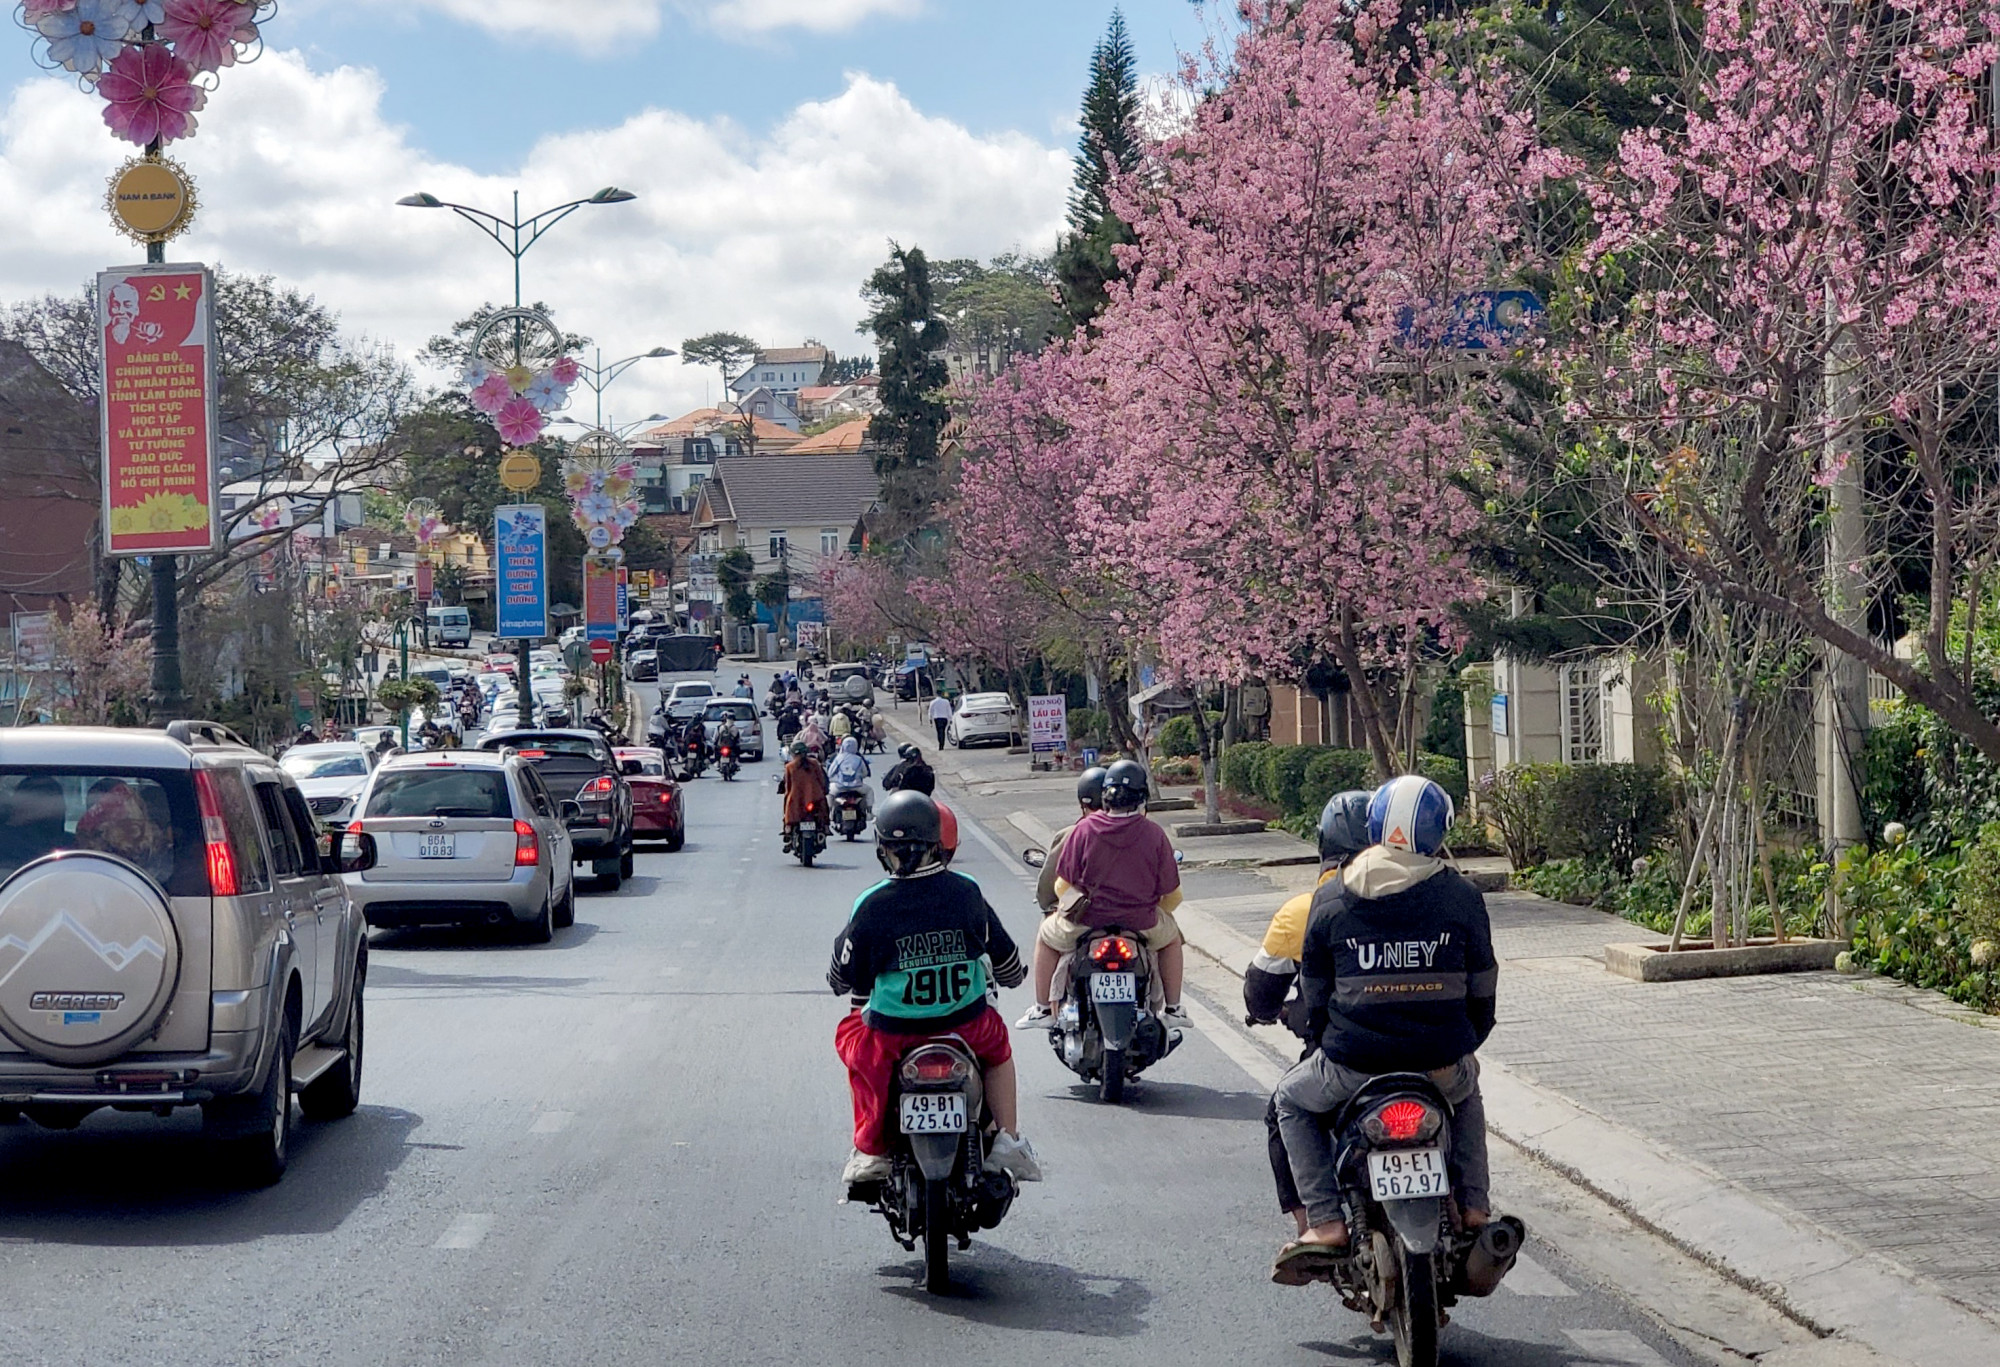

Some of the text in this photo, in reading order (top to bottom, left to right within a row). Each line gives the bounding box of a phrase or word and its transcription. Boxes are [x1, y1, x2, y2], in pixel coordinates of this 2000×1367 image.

[127, 351, 160, 363] ĐẢNG
[115, 363, 195, 377] CHÍNH QUYỀN
[115, 376, 196, 389] VÀ NHÂN DÂN
[140, 390, 166, 400] LÂM
[169, 387, 202, 398] ĐỒNG
[129, 401, 183, 413] TÍCH CỰC
[131, 413, 181, 427] HỌC TẬP
[118, 426, 195, 438] VÀ LÀM THEO
[128, 438, 185, 450] TƯ TƯỞNG
[131, 451, 183, 464] ĐẠO ĐỨC
[120, 463, 196, 476] PHONG CÁCH
[120, 476, 196, 488] HỒ CHÍ MINH
[501, 620, 543, 629] vinaphone
[1050, 708, 1062, 717] GÀ
[896, 930, 966, 961] KAPPA
[899, 957, 934, 969] GENUINE
[901, 963, 971, 1006] 1916
[1099, 974, 1127, 987] 49-B1
[1095, 987, 1132, 1000] 443.54
[31, 993, 124, 1010] EVEREST
[911, 1095, 954, 1112] 49-B1
[905, 1112, 963, 1131] 225.40
[1382, 1152, 1432, 1174] 49-E1
[1377, 1172, 1442, 1196] 562.97
